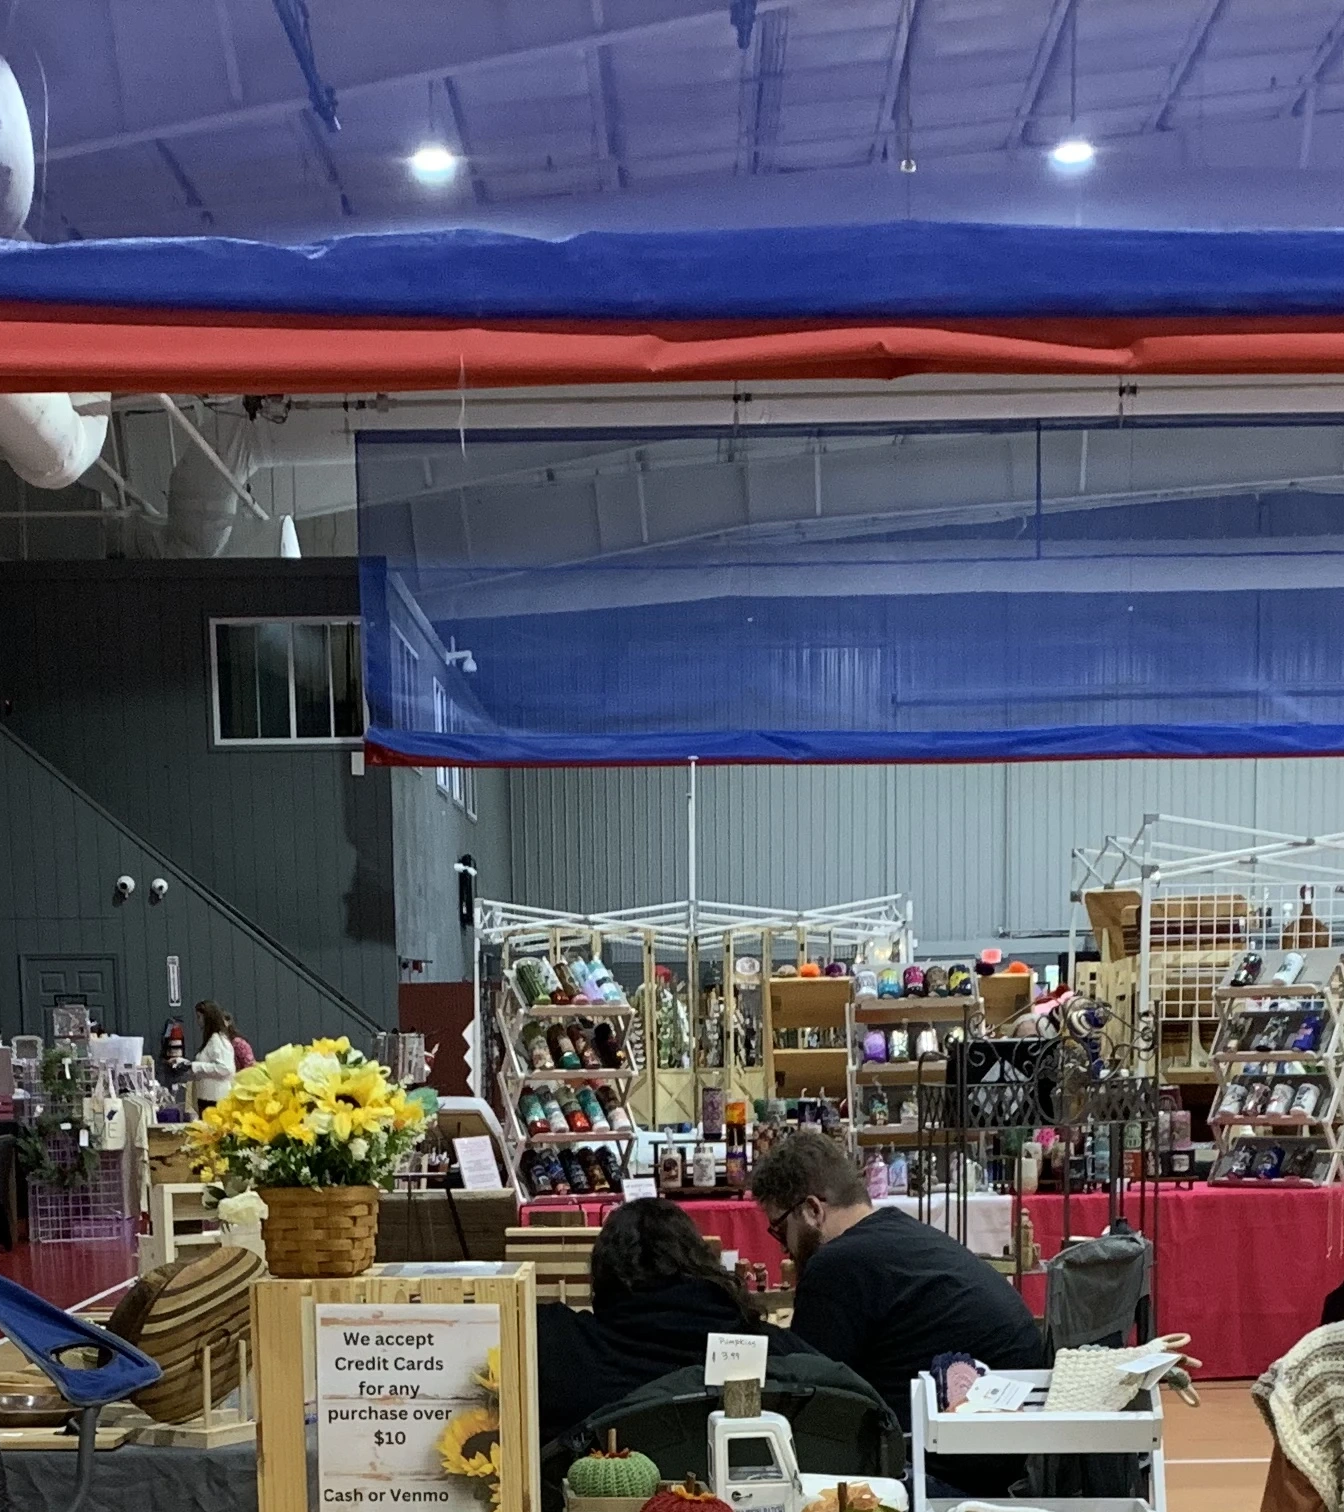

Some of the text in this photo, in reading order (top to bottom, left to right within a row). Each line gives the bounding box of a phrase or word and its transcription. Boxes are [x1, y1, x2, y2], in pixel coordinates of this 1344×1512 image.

[343, 1331, 435, 1350] We accept
[334, 1355, 444, 1371] Credit Cards
[358, 1380, 421, 1400] for any
[327, 1405, 453, 1424] purchase over
[373, 1429, 406, 1447] $10
[323, 1488, 449, 1503] Cash or Venmo
